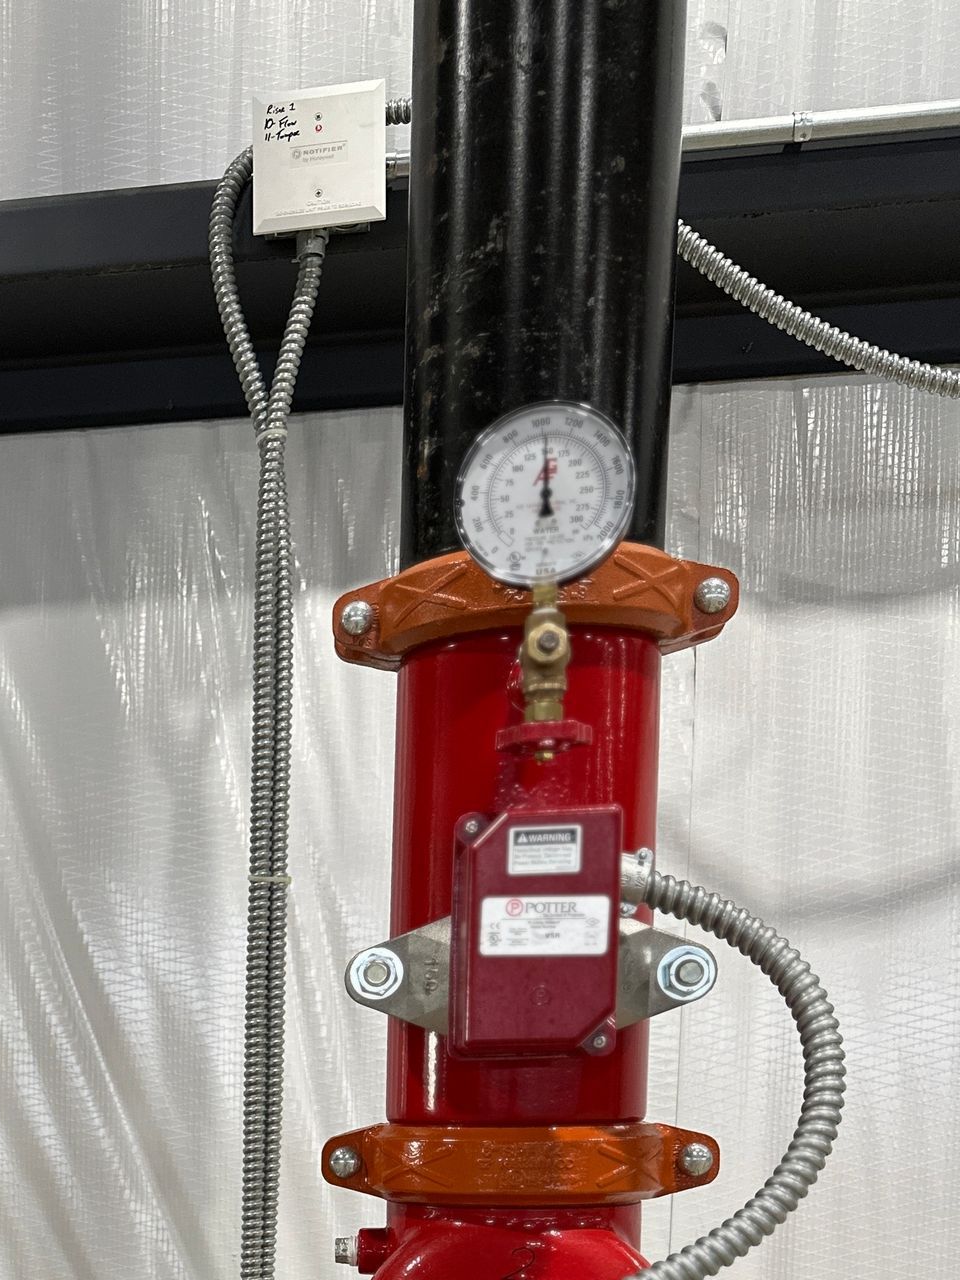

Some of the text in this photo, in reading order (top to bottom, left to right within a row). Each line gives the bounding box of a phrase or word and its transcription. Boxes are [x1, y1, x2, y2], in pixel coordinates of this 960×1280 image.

[289, 102, 296, 111] 1
[279, 115, 297, 128] Flow
[303, 145, 343, 156] NOTIFIER
[531, 417, 550, 428] 1000
[565, 417, 584, 428] 1200
[502, 430, 519, 444] 800
[593, 430, 610, 447] 1400
[479, 454, 493, 470] 600
[611, 455, 624, 475] 1600
[470, 485, 480, 501] 400
[614, 489, 624, 509] 1800
[472, 518, 483, 532] 200
[597, 521, 614, 541] 2000
[529, 833, 571, 842] WARNING
[526, 901, 577, 914] POTTER
